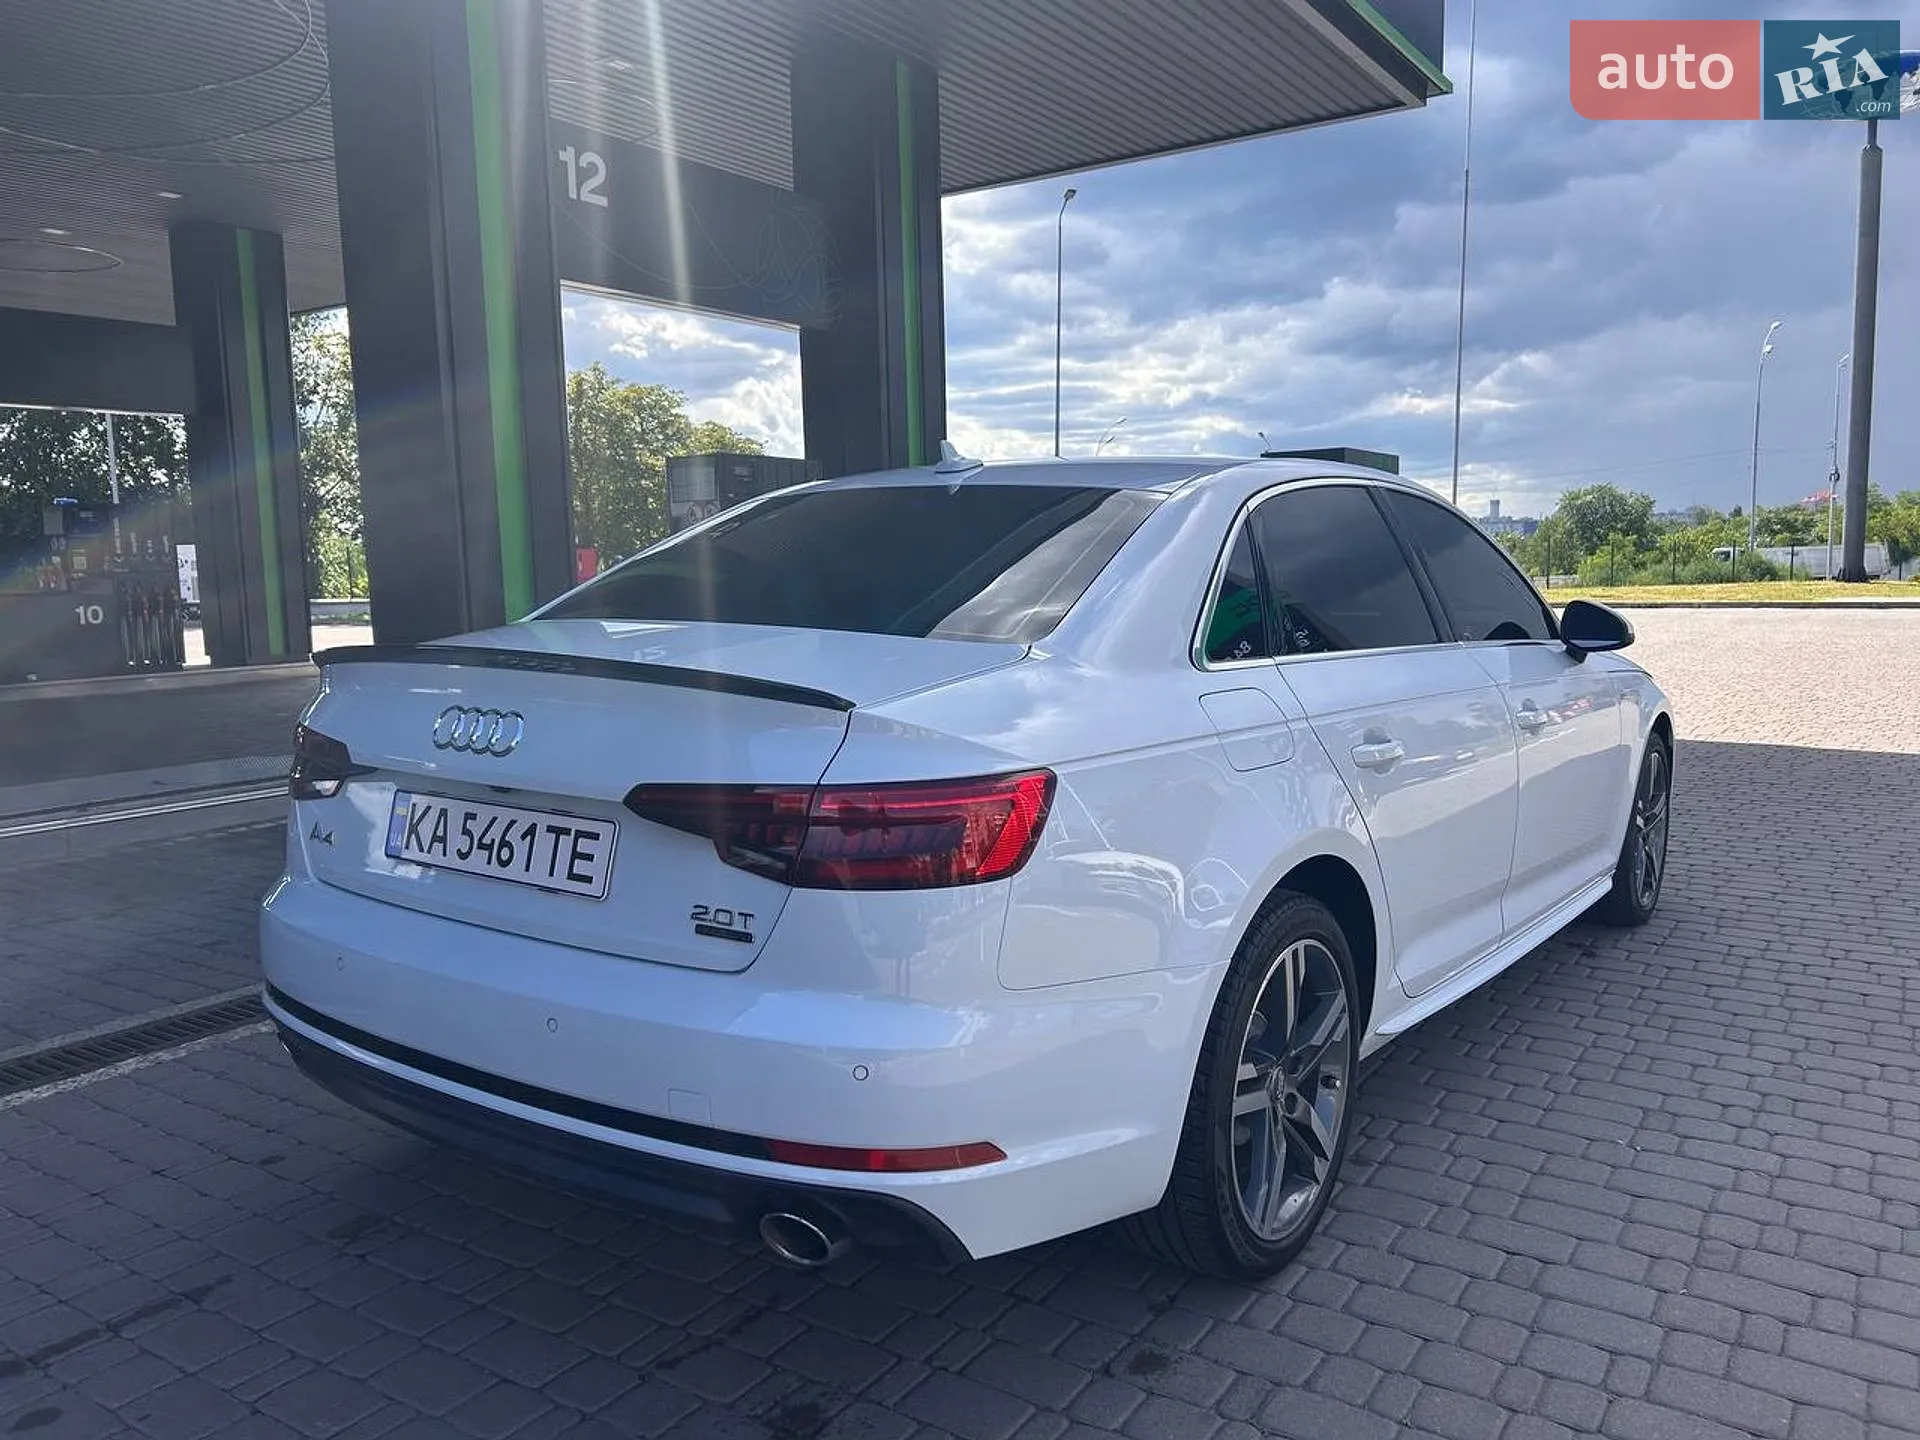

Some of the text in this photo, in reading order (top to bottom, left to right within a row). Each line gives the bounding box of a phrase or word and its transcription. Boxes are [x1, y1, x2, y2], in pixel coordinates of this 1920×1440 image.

[559, 144, 608, 208] 12
[75, 605, 103, 625] 10
[309, 820, 334, 847] A4
